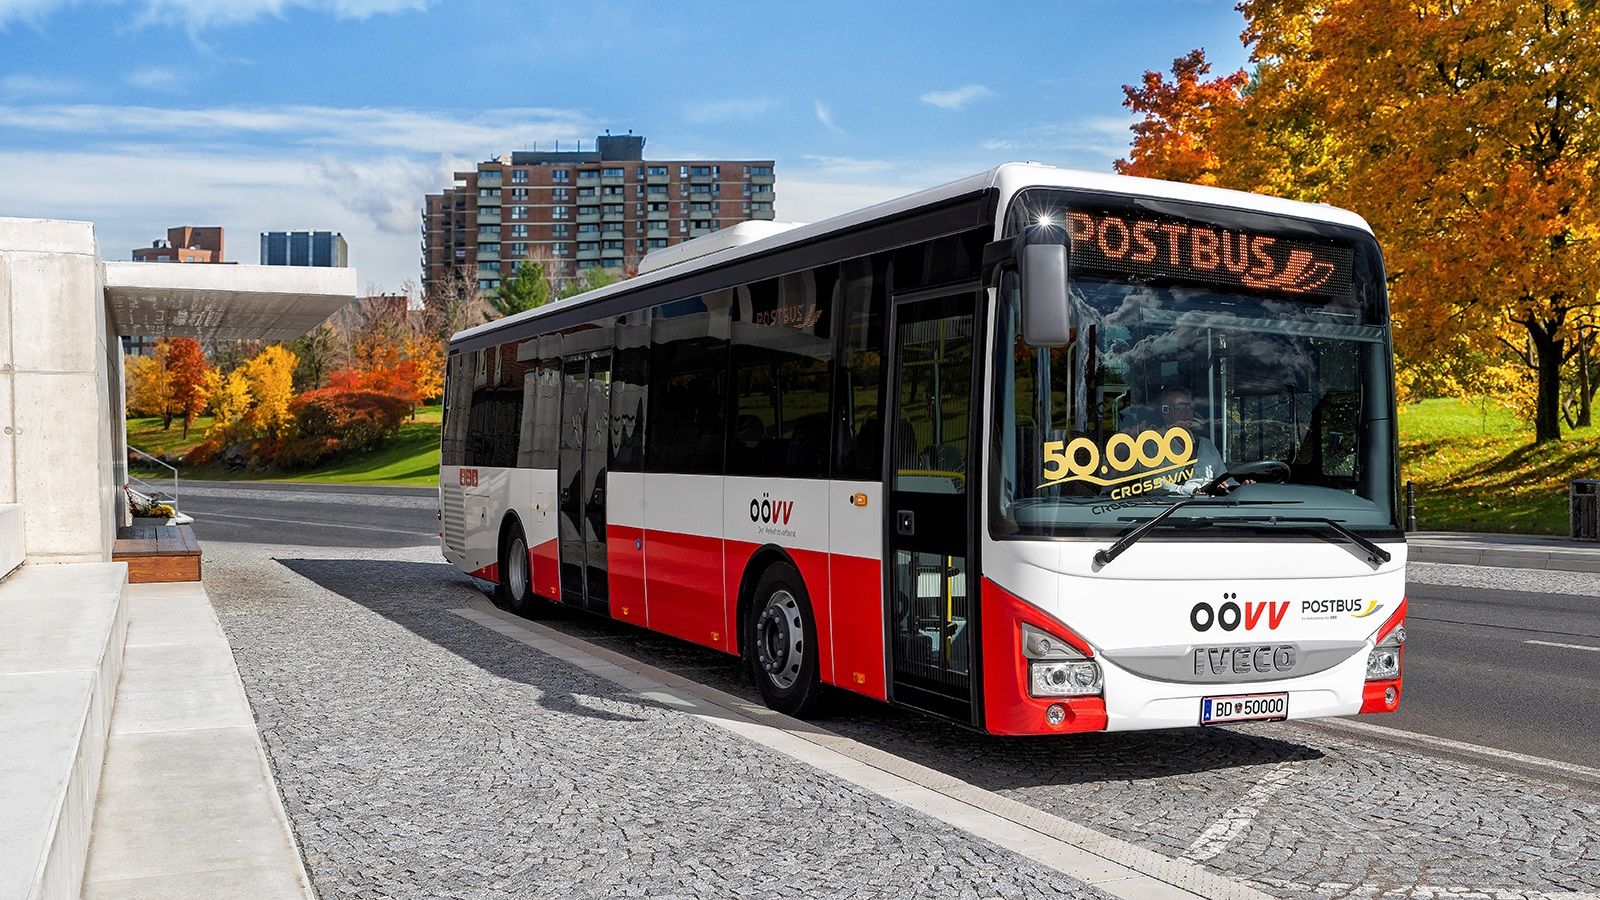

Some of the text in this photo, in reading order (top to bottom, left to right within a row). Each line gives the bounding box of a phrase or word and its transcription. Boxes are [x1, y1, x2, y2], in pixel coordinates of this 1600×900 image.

[1065, 212, 1276, 275] POSTBUS
[1043, 426, 1194, 480] 50.000
[1110, 468, 1195, 500] CROSSWAY
[749, 492, 794, 525] OÖVV
[1190, 592, 1291, 632] OÖVV
[1301, 598, 1362, 613] POSTBUS
[1193, 645, 1297, 676] IVECO
[1215, 698, 1284, 717] BD 50000
